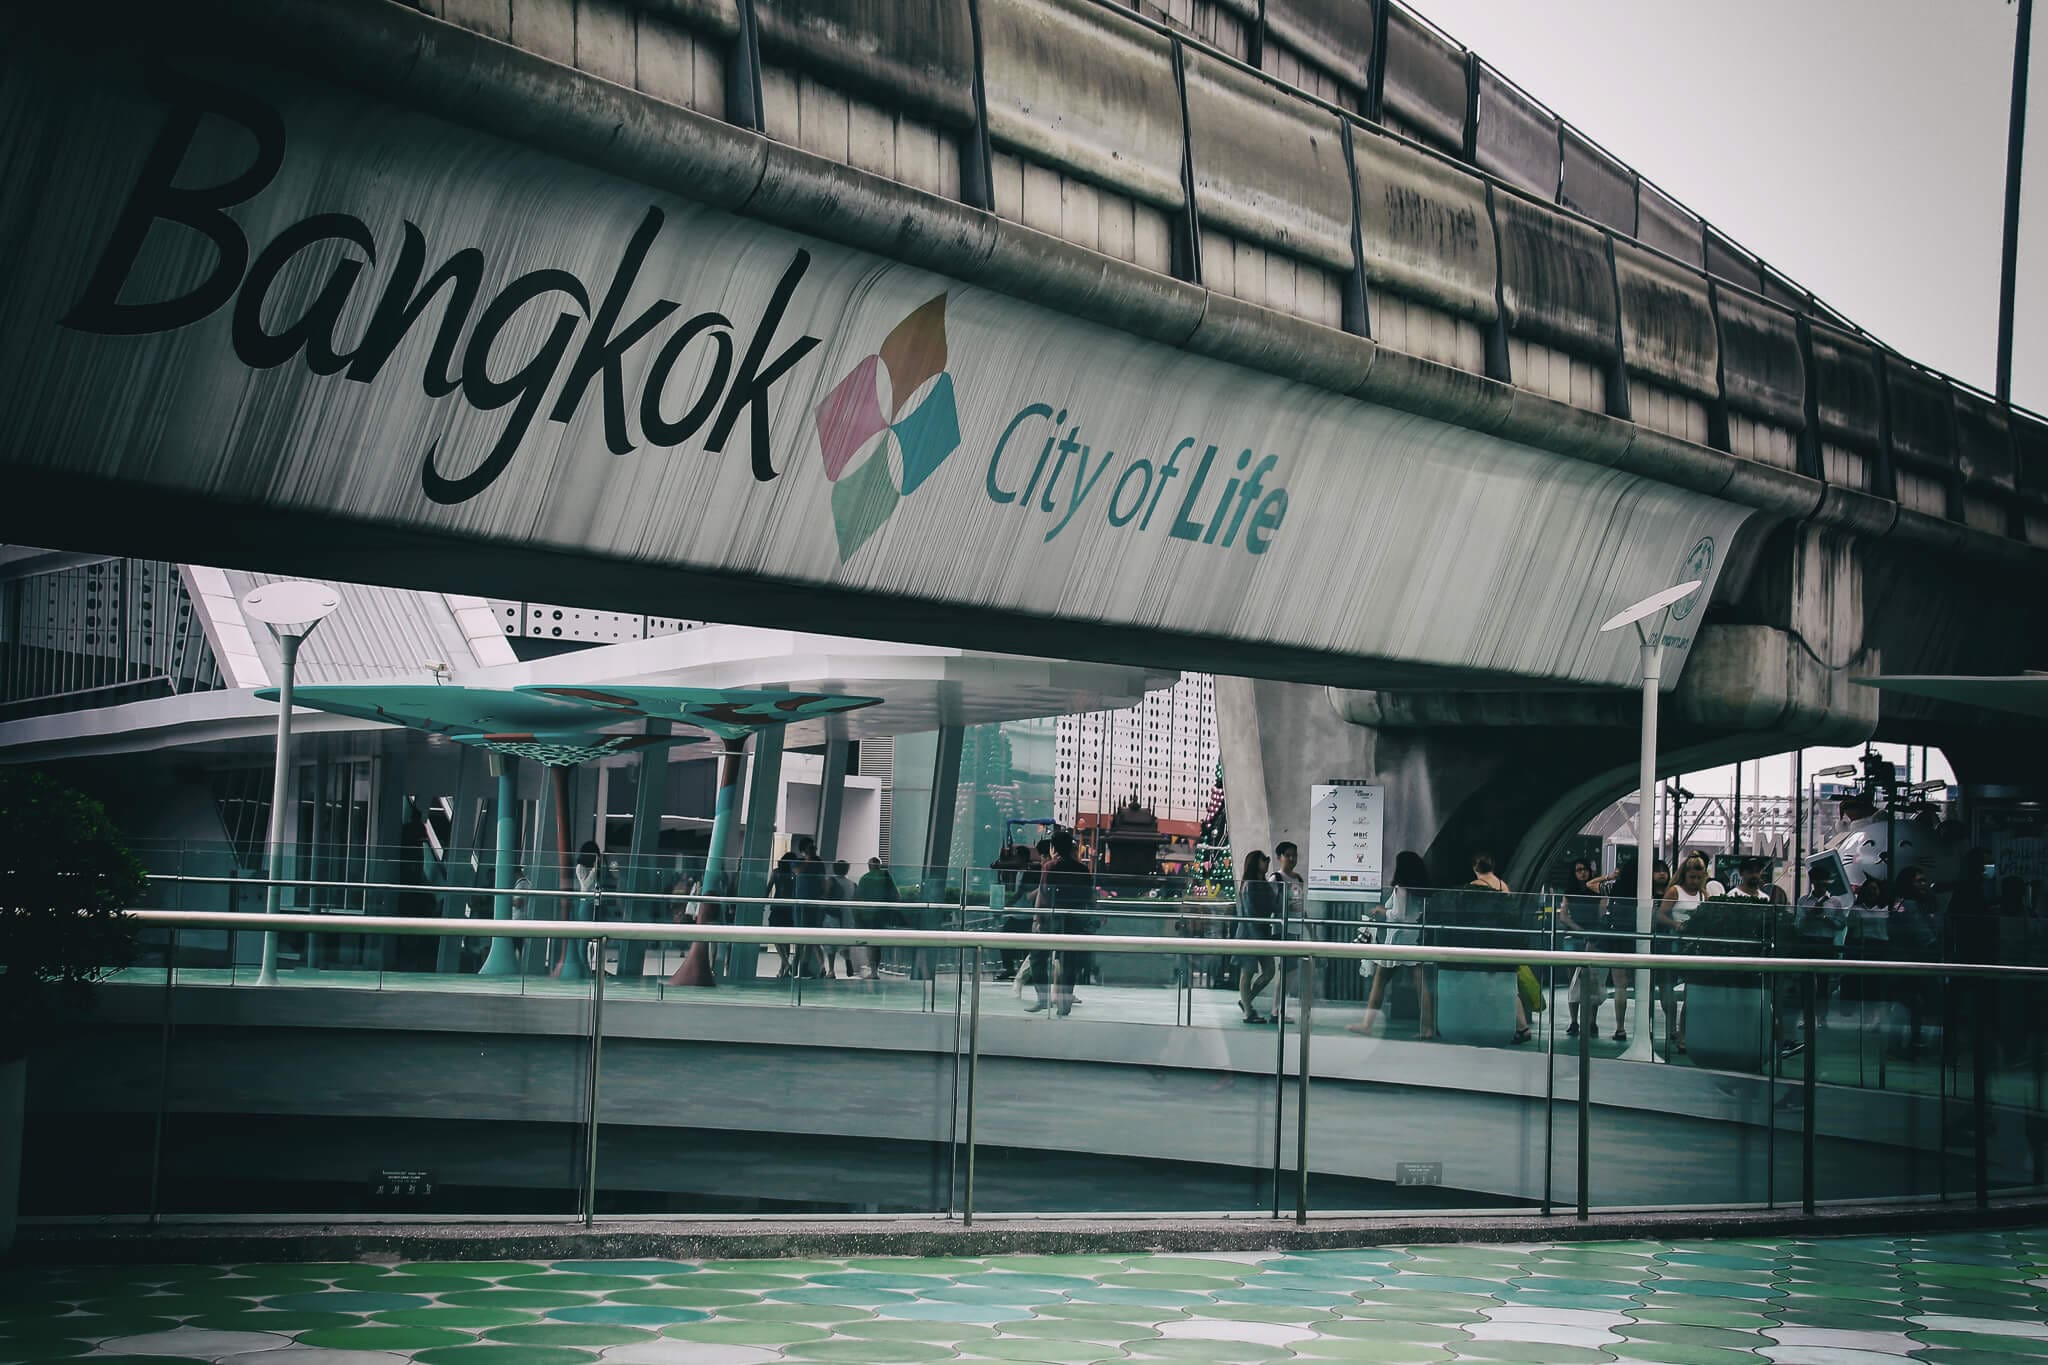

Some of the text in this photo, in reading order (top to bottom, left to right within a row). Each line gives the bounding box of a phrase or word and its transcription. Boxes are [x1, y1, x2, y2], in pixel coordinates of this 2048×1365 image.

[57, 62, 821, 505] Bangkok
[985, 402, 1289, 555] City of Life
